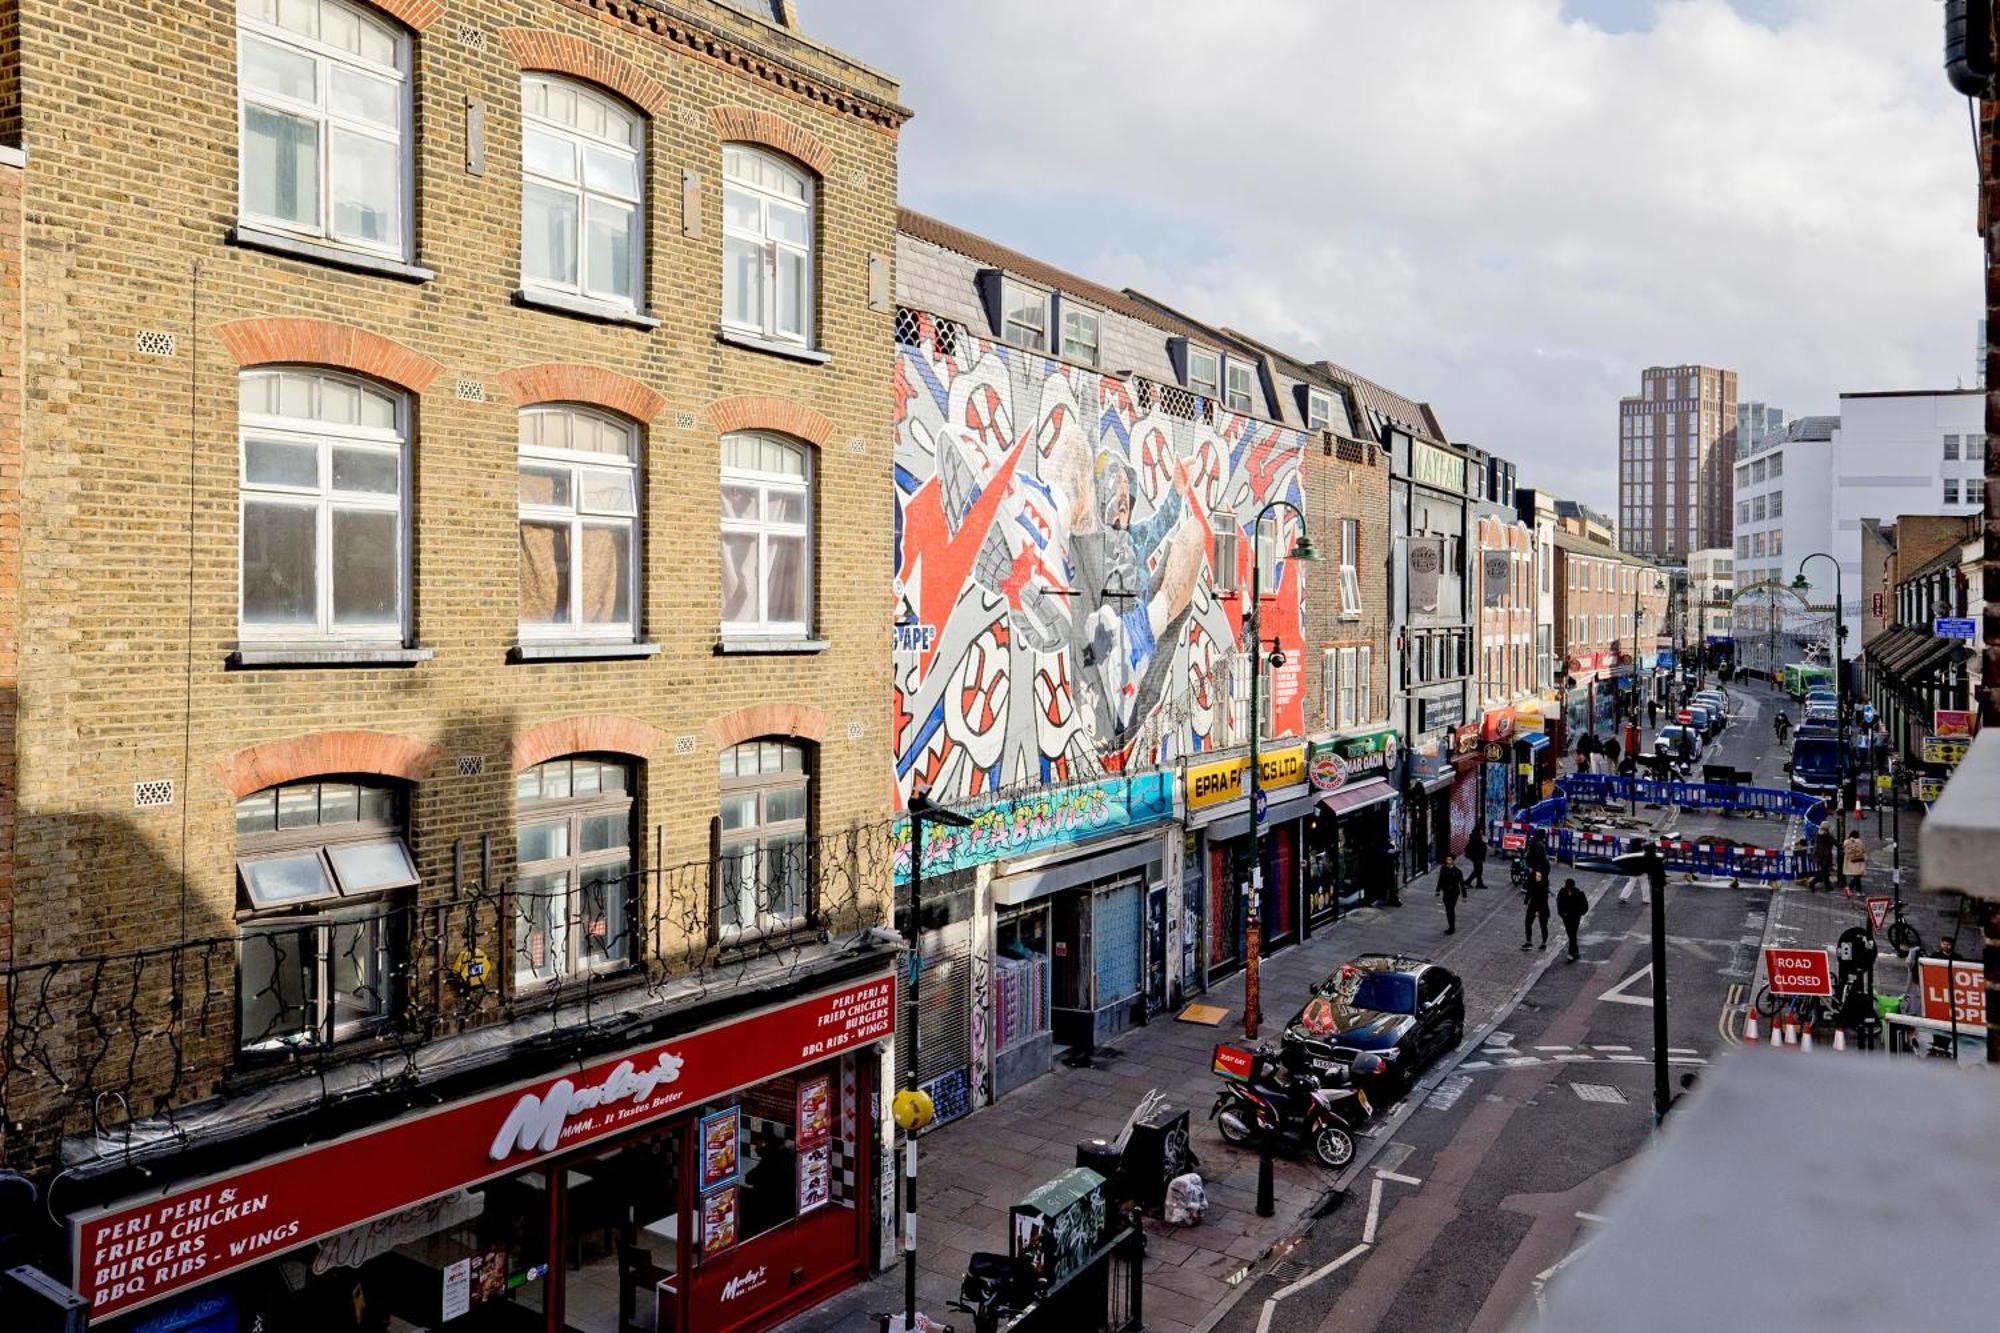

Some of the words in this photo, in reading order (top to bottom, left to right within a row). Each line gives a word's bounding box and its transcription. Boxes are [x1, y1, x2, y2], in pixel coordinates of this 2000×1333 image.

[1195, 771, 1228, 798] EPRA
[1230, 761, 1277, 789] FACS
[1279, 757, 1297, 777] LTD
[1345, 757, 1363, 774] MAR
[1364, 752, 1384, 770] GAON
[1774, 975, 1821, 986] CLOSED
[1778, 958, 1811, 969] ROAD
[817, 1009, 846, 1027] FRIED
[848, 996, 889, 1017] CHICKEN
[833, 994, 854, 1010] PERI
[857, 987, 878, 1002] PERI
[880, 984, 889, 994] &
[845, 1008, 889, 1030] BURGERS
[802, 1042, 823, 1057] BBQ
[826, 1032, 849, 1049] RIBS
[857, 1020, 889, 1038] WINGS
[1234, 1058, 1246, 1066] EAT
[489, 1052, 684, 1160] Morley's
[604, 1112, 614, 1125] It
[618, 1103, 650, 1120] Tastes
[652, 1091, 684, 1108] Better
[94, 1230, 164, 1266] FRIED
[170, 1195, 268, 1239] CHICKEN
[96, 1214, 152, 1245] PERI
[160, 1195, 211, 1224] PERI
[218, 1187, 238, 1204] &
[94, 1235, 205, 1286] BURGERS
[94, 1276, 145, 1307] BBQ
[154, 1253, 207, 1285] RIBS
[229, 1220, 300, 1257] WINGS
